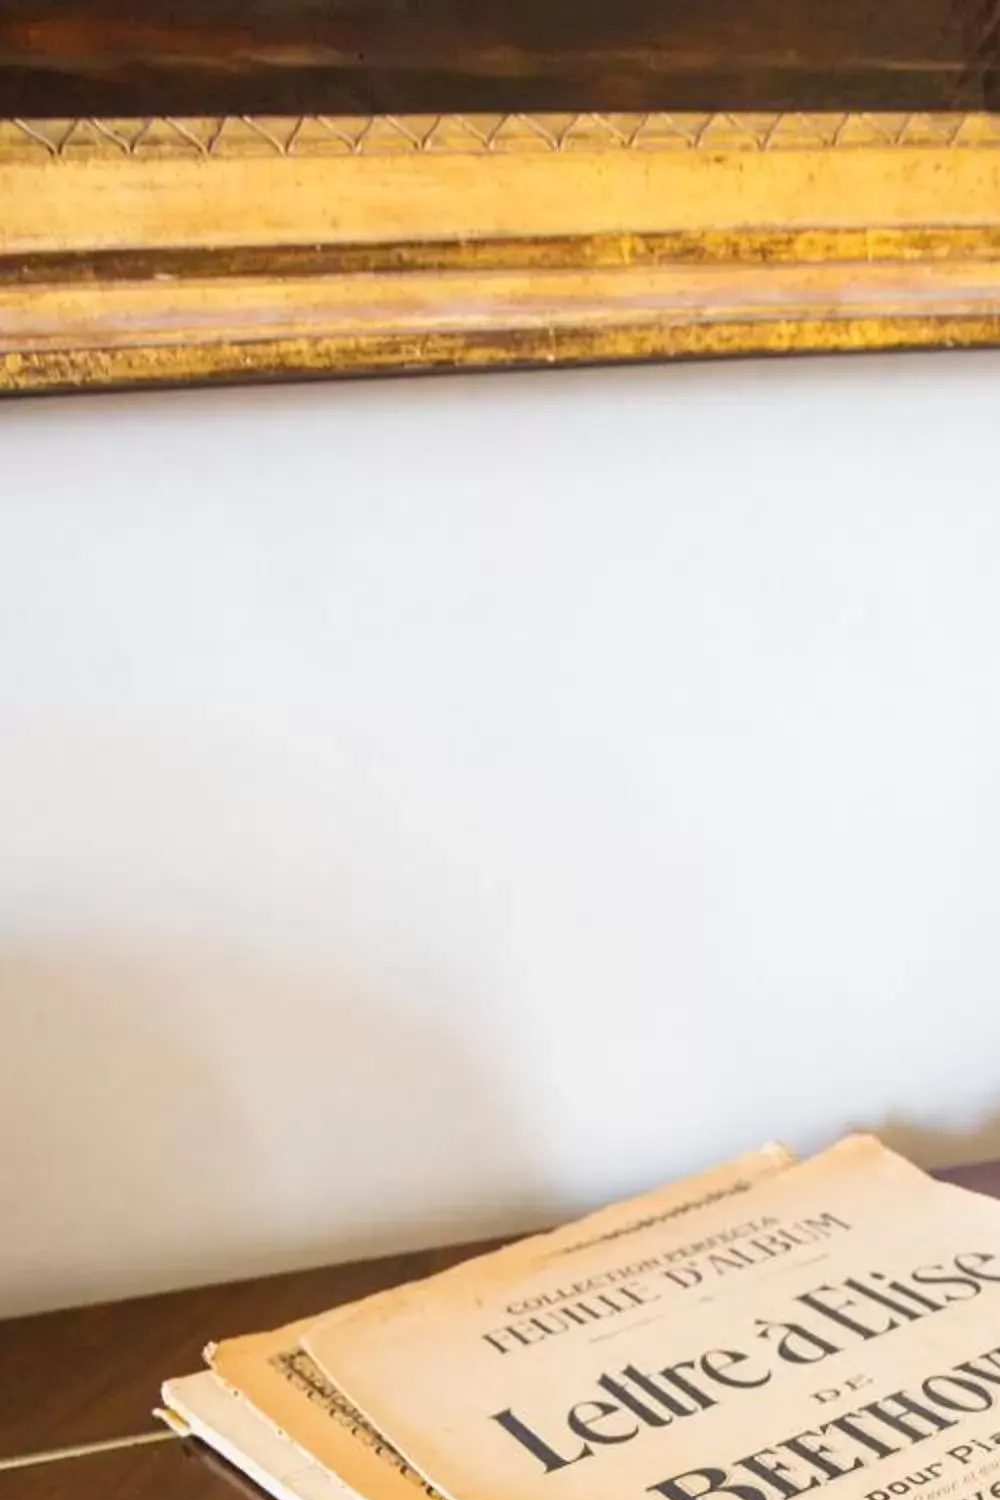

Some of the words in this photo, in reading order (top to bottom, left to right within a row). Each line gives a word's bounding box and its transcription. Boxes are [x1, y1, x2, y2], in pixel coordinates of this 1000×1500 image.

[482, 1280, 662, 1354] FEUILLE
[662, 1211, 852, 1289] D'ALBUM
[505, 1255, 661, 1315] COLLECTION
[488, 1348, 773, 1474] Lettre
[754, 1318, 846, 1364] à
[810, 1373, 874, 1404] DE
